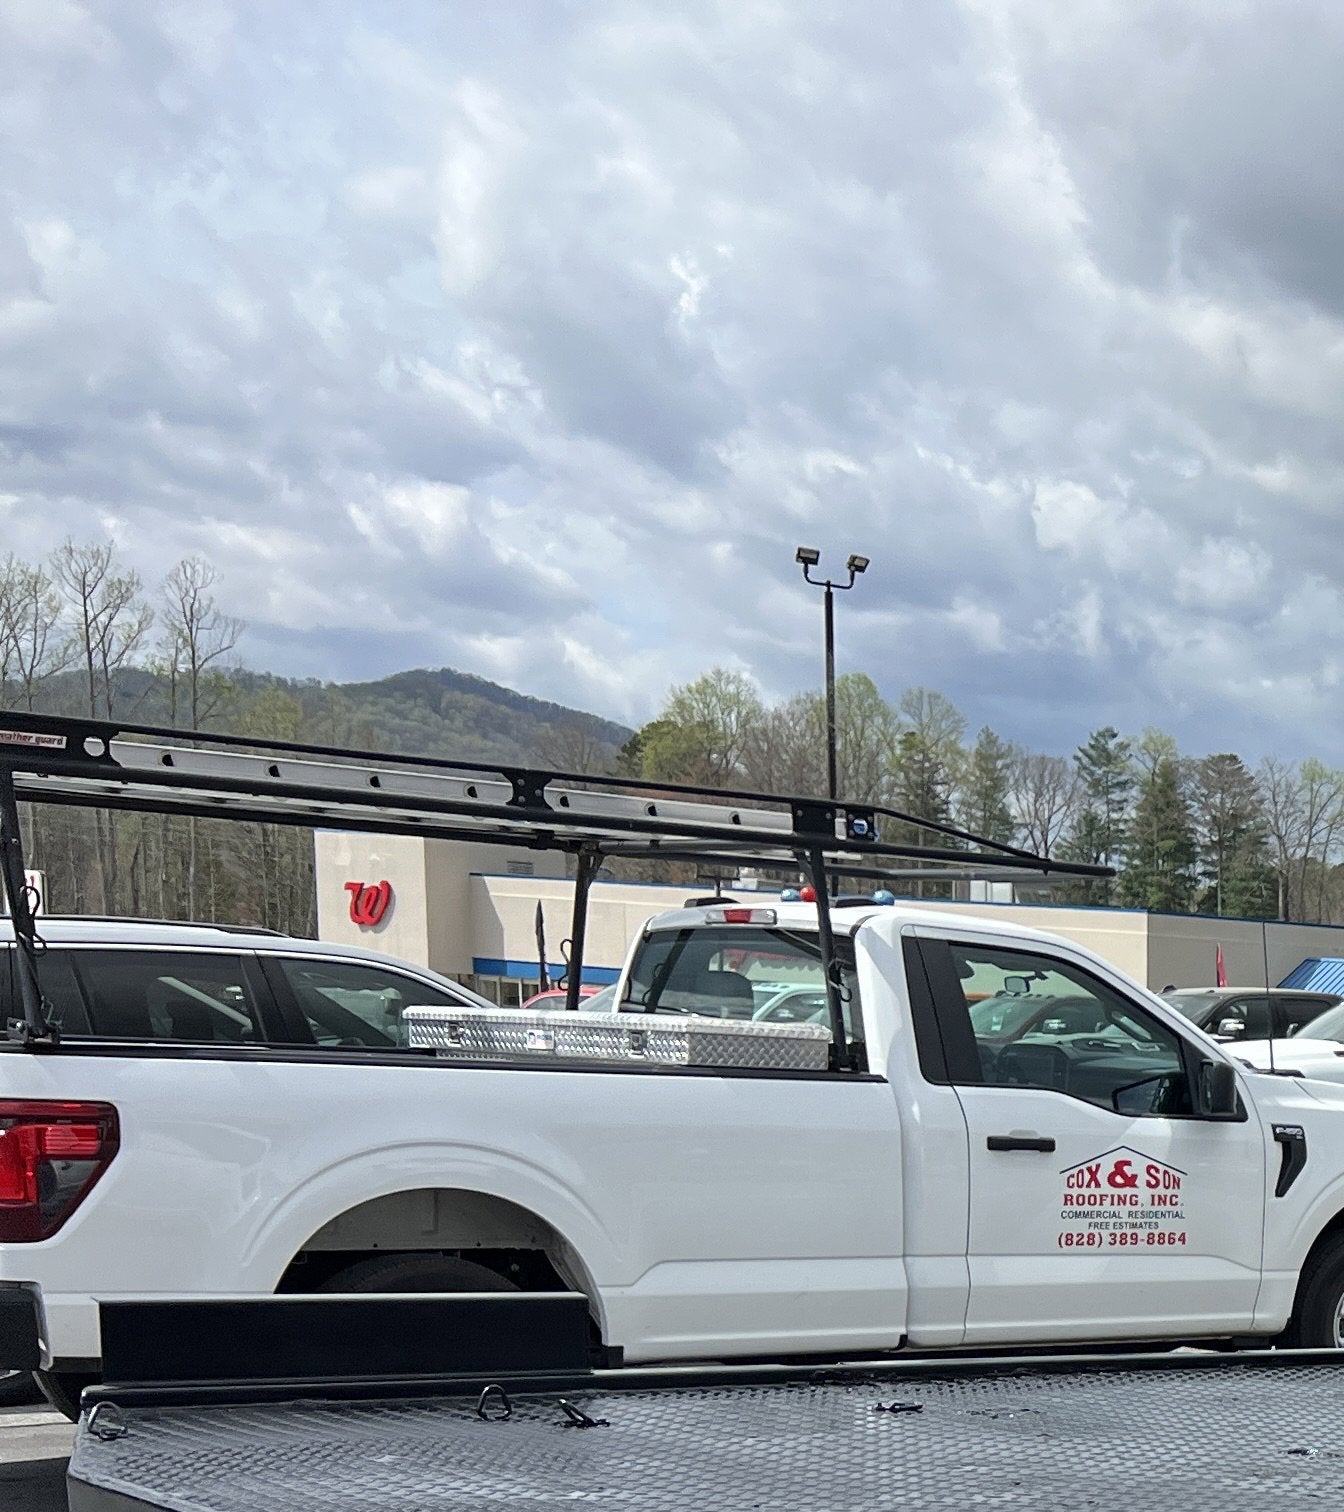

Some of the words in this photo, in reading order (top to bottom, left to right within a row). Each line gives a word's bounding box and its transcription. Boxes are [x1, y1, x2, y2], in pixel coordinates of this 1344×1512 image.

[344, 880, 392, 926] W
[1066, 1163, 1102, 1189] COX
[1107, 1160, 1138, 1188] &
[1145, 1164, 1181, 1190] SON
[1150, 1194, 1184, 1206] INC.
[1060, 1210, 1123, 1219] COMMERCIAL
[1127, 1210, 1185, 1219] RESIDENTIAL
[1088, 1221, 1110, 1230] FREE
[1112, 1221, 1159, 1230] ESTIMATES
[1057, 1232, 1103, 1248] (828)
[1108, 1232, 1186, 1246] 389-8864
